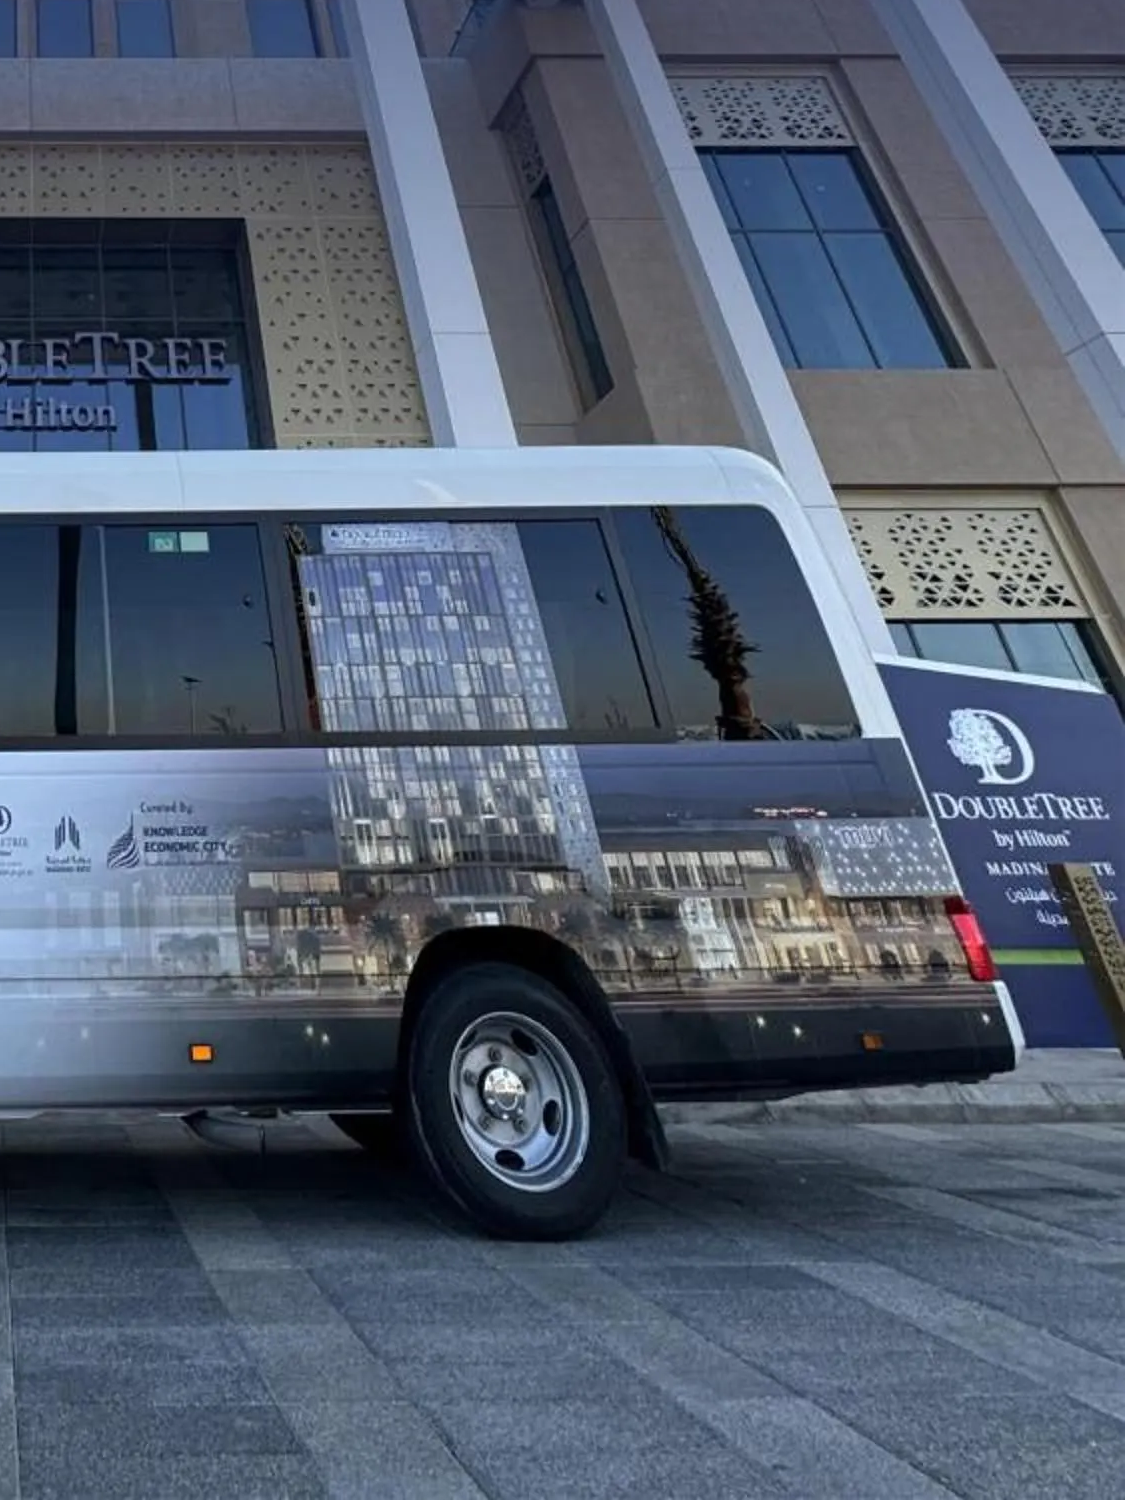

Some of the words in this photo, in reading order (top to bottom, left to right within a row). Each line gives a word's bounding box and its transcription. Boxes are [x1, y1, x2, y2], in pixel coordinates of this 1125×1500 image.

[4, 399, 118, 431] Hilton
[933, 793, 1110, 821] DOUBLETREE
[143, 826, 208, 837] KNOWLEDGE
[992, 829, 1014, 851] by
